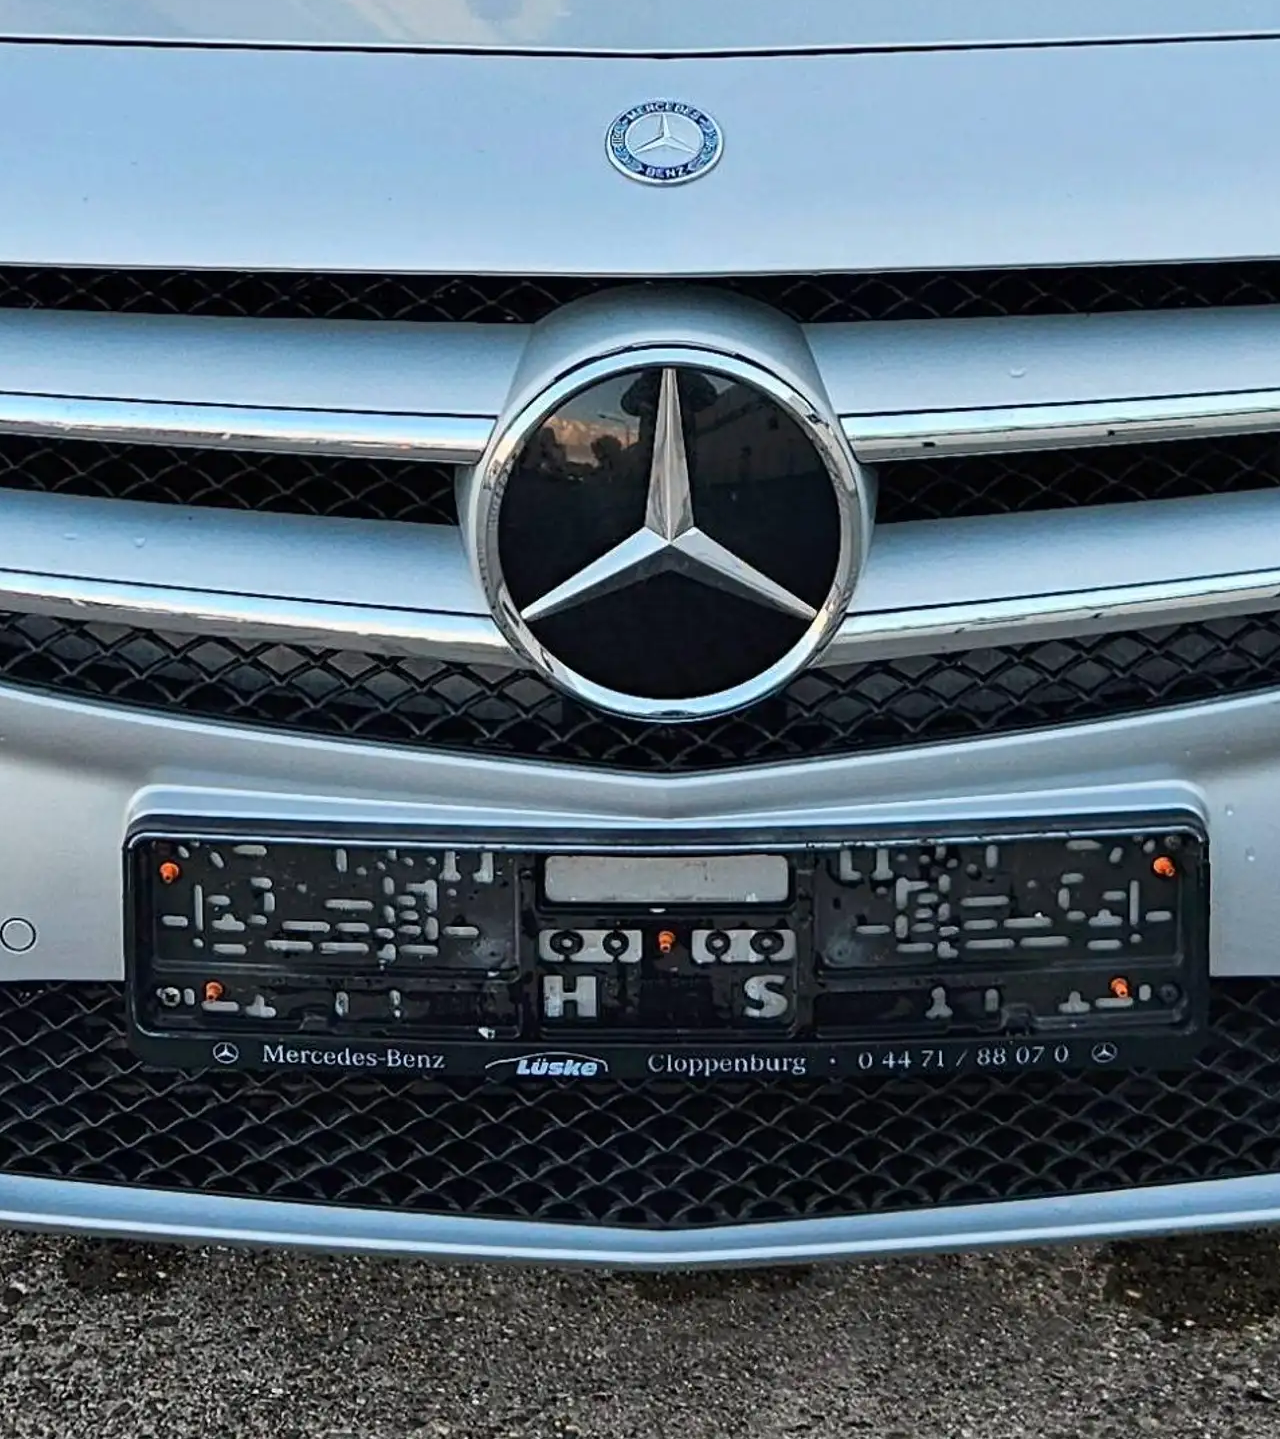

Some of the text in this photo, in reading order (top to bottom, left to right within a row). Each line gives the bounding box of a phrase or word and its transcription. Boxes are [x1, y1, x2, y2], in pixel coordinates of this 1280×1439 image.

[645, 166, 688, 179] BENZ
[262, 1044, 445, 1069] Mercedes-Benz
[516, 1057, 598, 1076] Lüske
[648, 1053, 806, 1076] Cloppenburg
